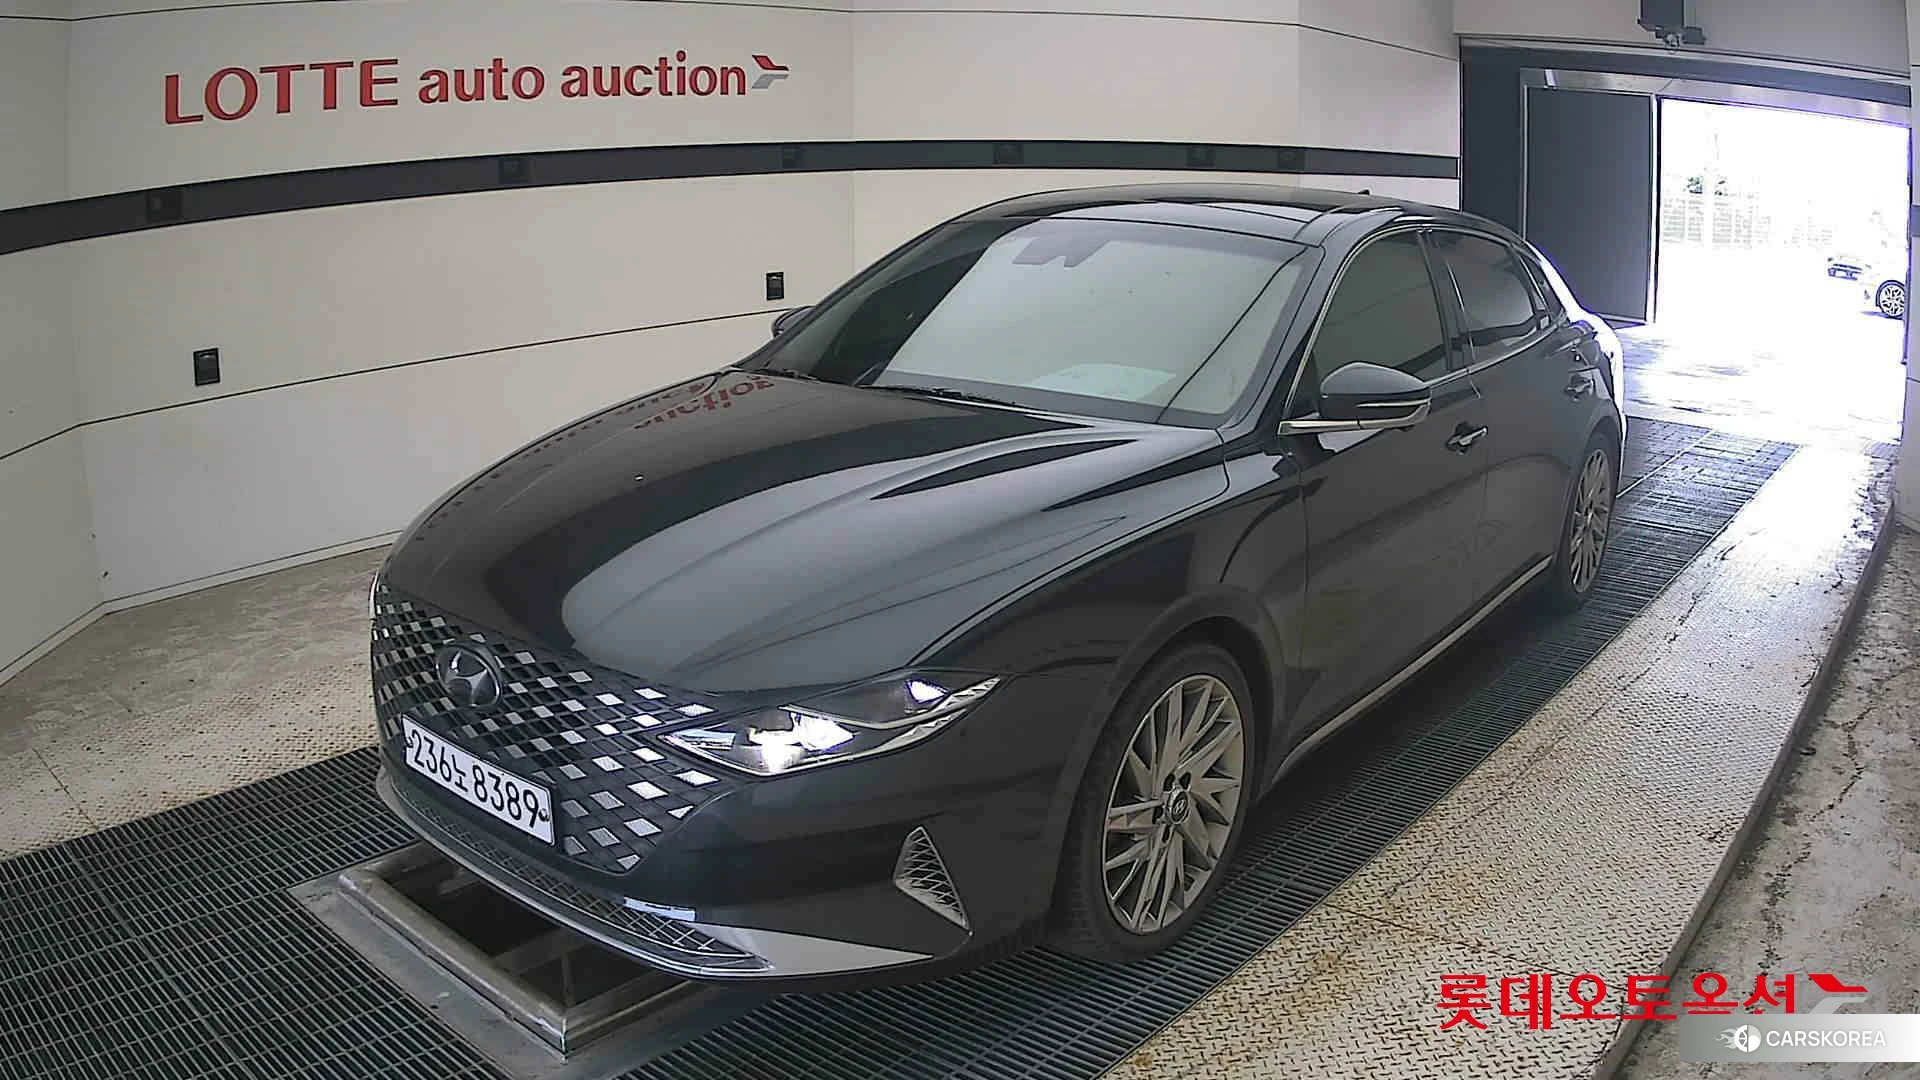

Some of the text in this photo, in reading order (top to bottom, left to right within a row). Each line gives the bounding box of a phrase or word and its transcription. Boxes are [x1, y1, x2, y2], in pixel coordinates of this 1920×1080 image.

[164, 49, 747, 125] LOTTE auto auction
